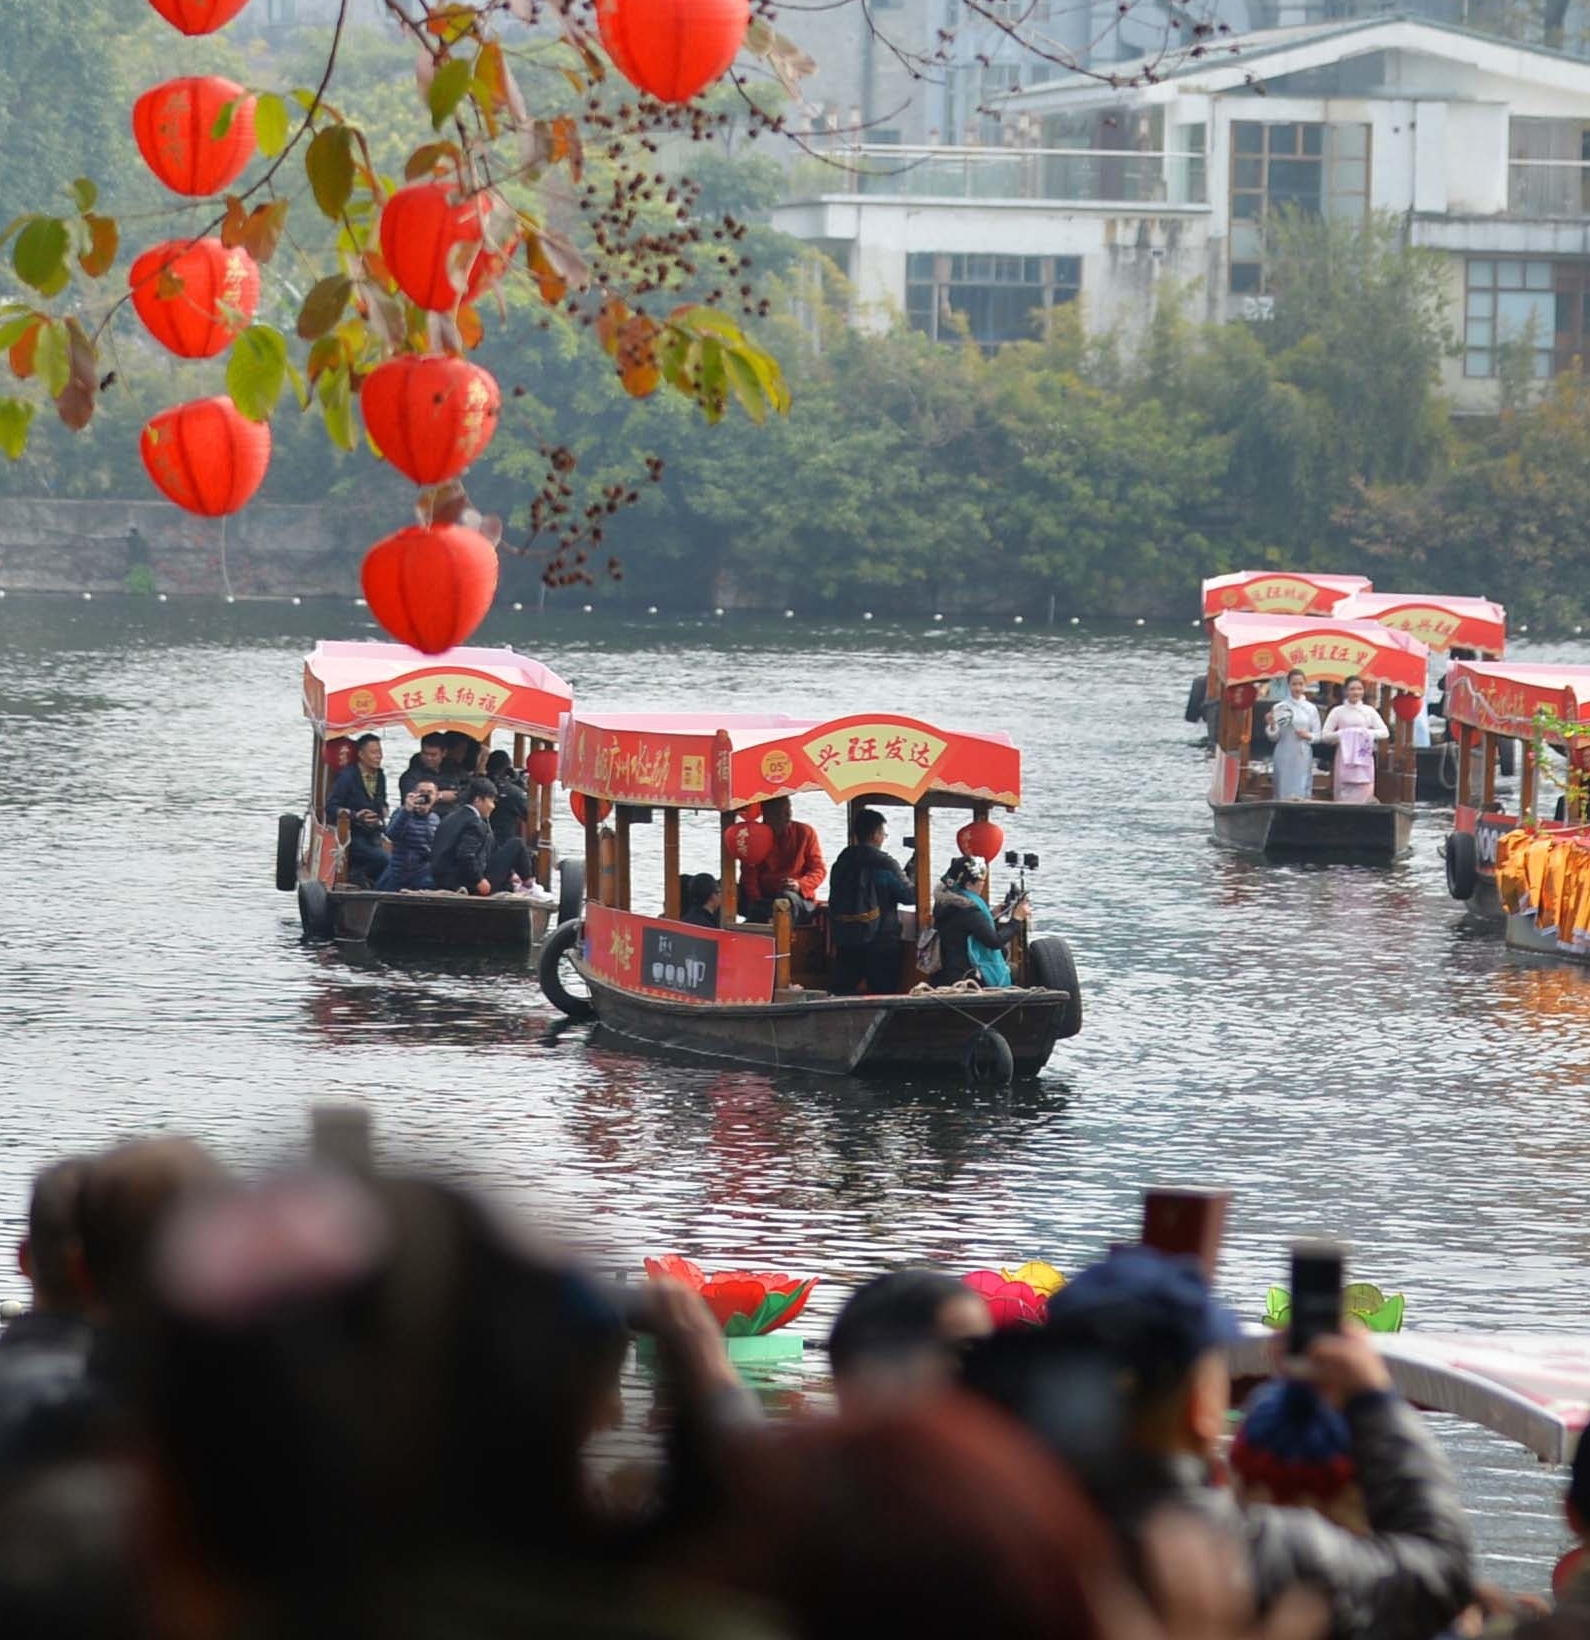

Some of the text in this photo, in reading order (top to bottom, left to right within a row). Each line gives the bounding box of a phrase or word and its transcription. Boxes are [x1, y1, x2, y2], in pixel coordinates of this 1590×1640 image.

[402, 683, 498, 713] 旺春纳福
[817, 735, 933, 772] 兴旺发达
